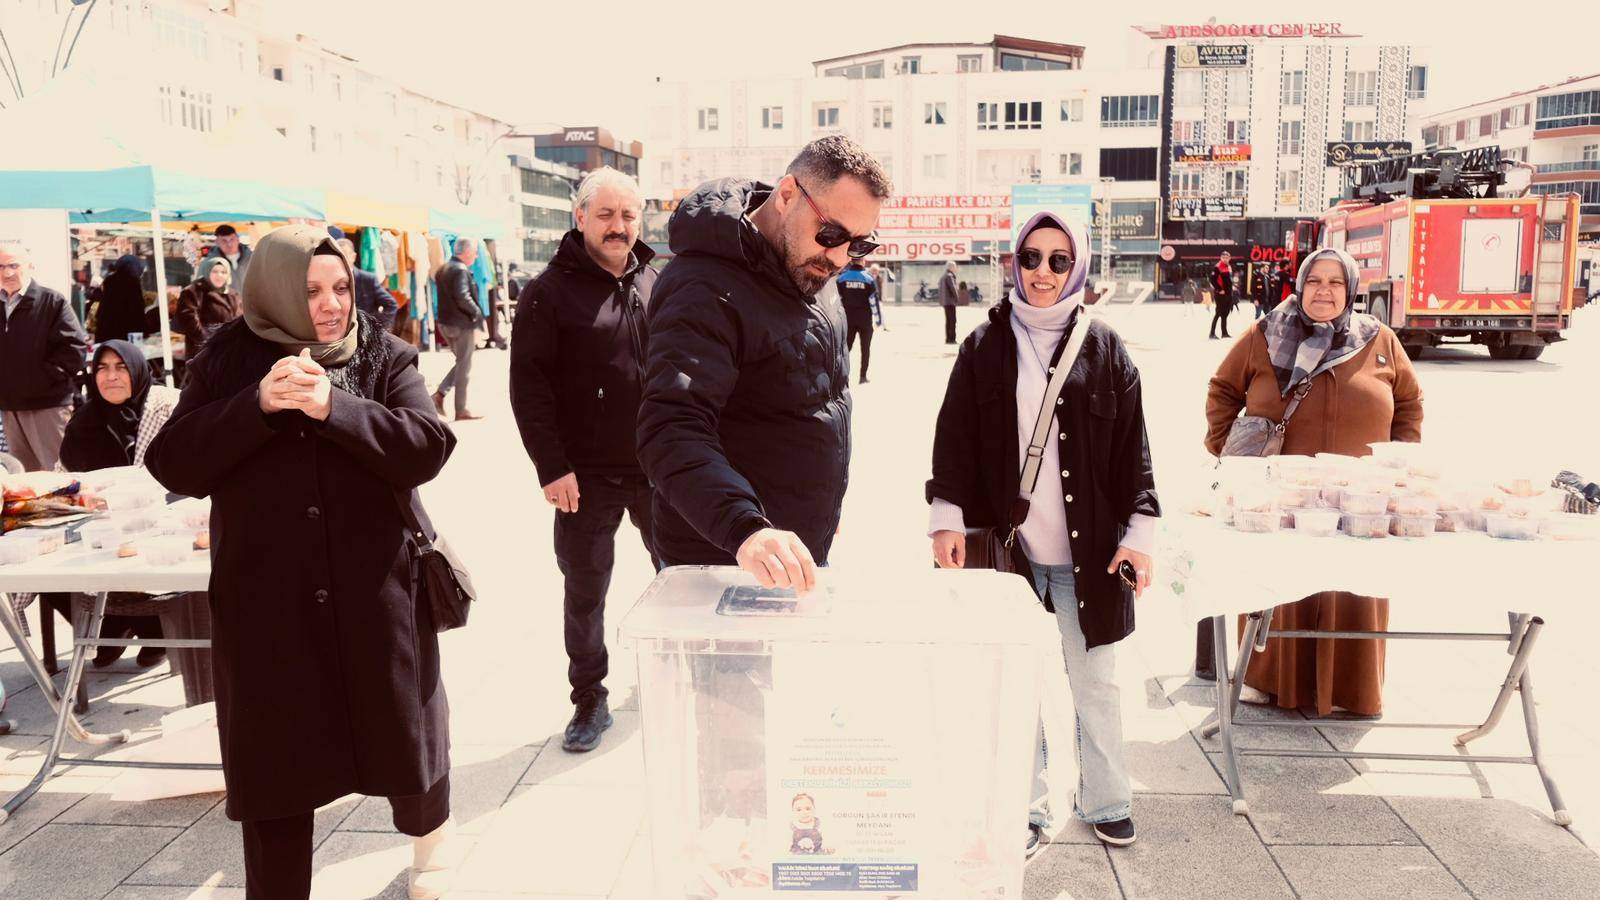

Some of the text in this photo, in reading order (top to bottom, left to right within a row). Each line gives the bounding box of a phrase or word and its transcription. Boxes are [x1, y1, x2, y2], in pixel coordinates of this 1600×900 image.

[1268, 22, 1342, 36] CENTER
[1200, 46, 1244, 55] AVUKAT
[564, 131, 595, 142] ATAC
[1213, 145, 1239, 155] tur
[906, 243, 966, 260] gross
